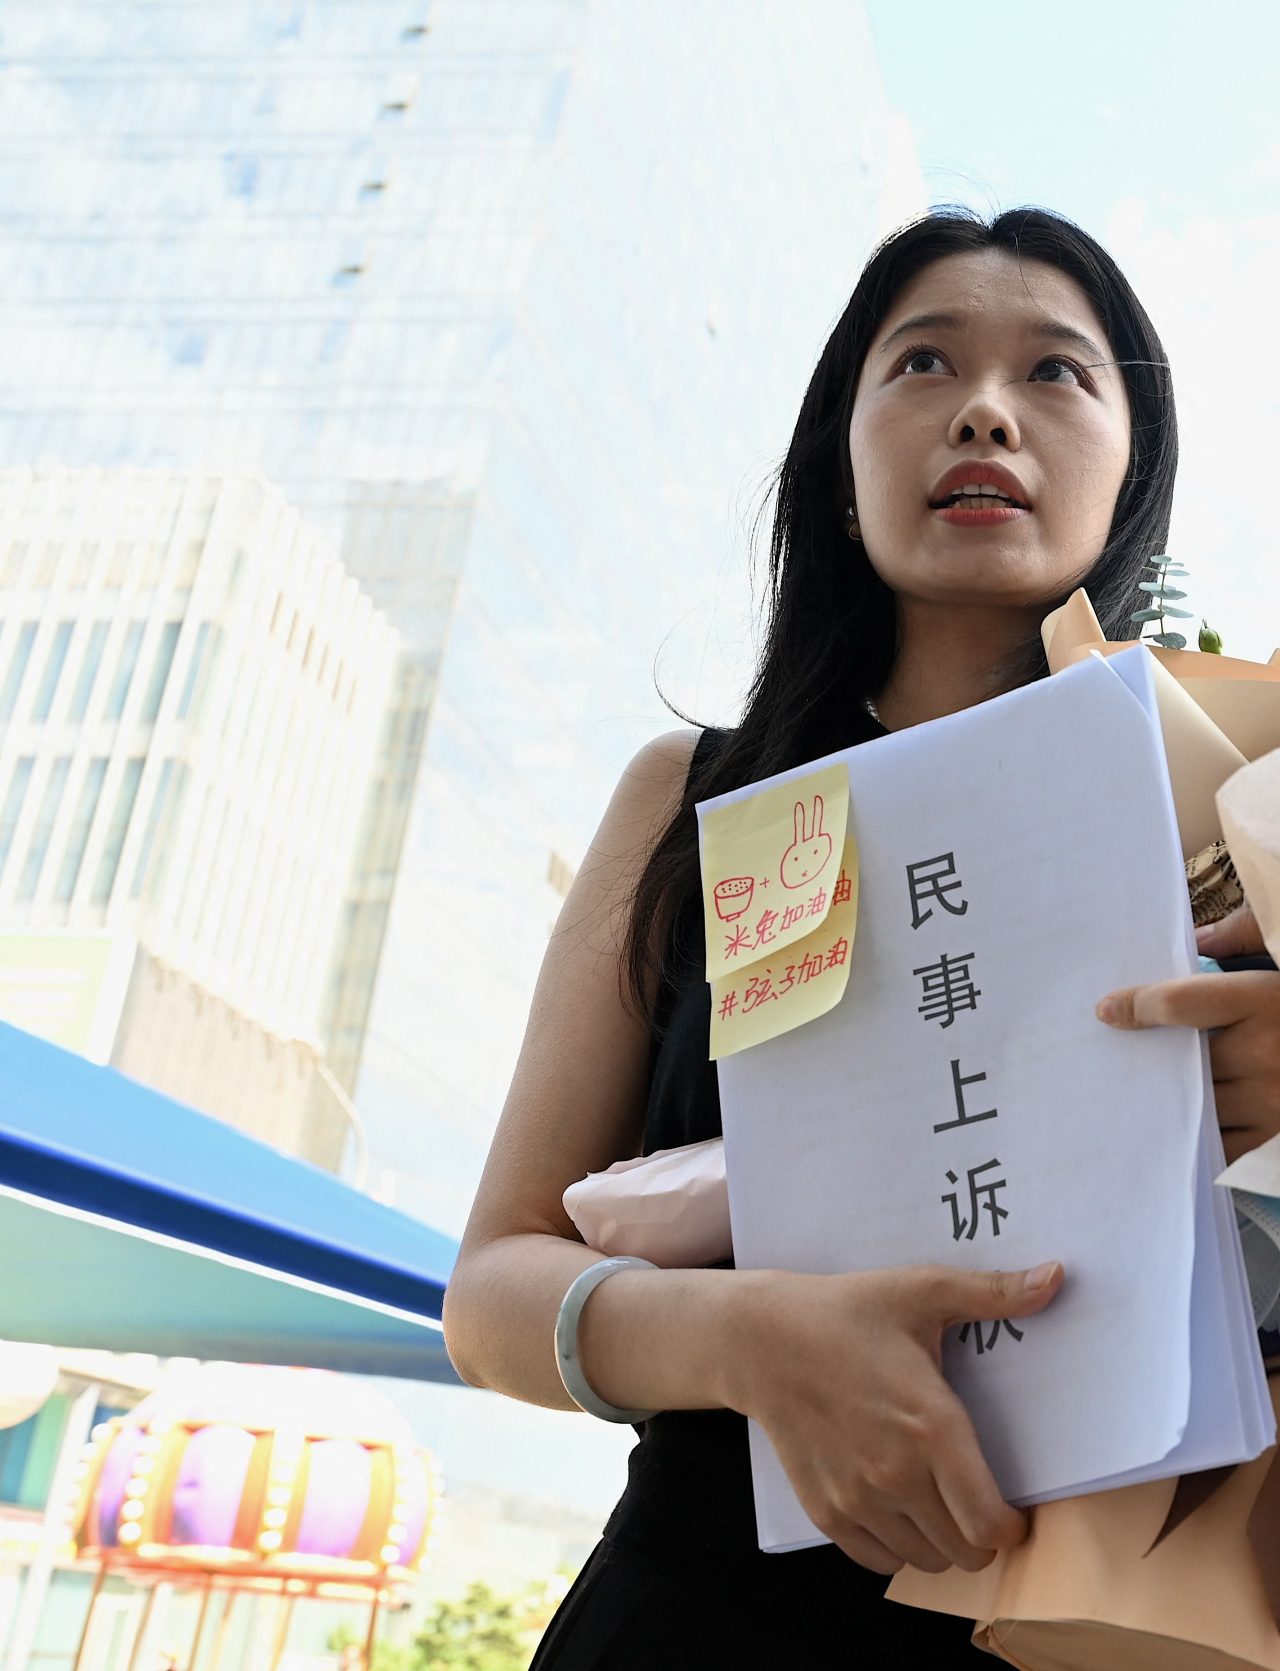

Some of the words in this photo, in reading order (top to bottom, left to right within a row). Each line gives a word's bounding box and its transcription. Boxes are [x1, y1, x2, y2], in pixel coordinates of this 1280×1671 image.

[724, 886, 827, 960] 米兔加油
[718, 936, 848, 1021] #弦子加油
